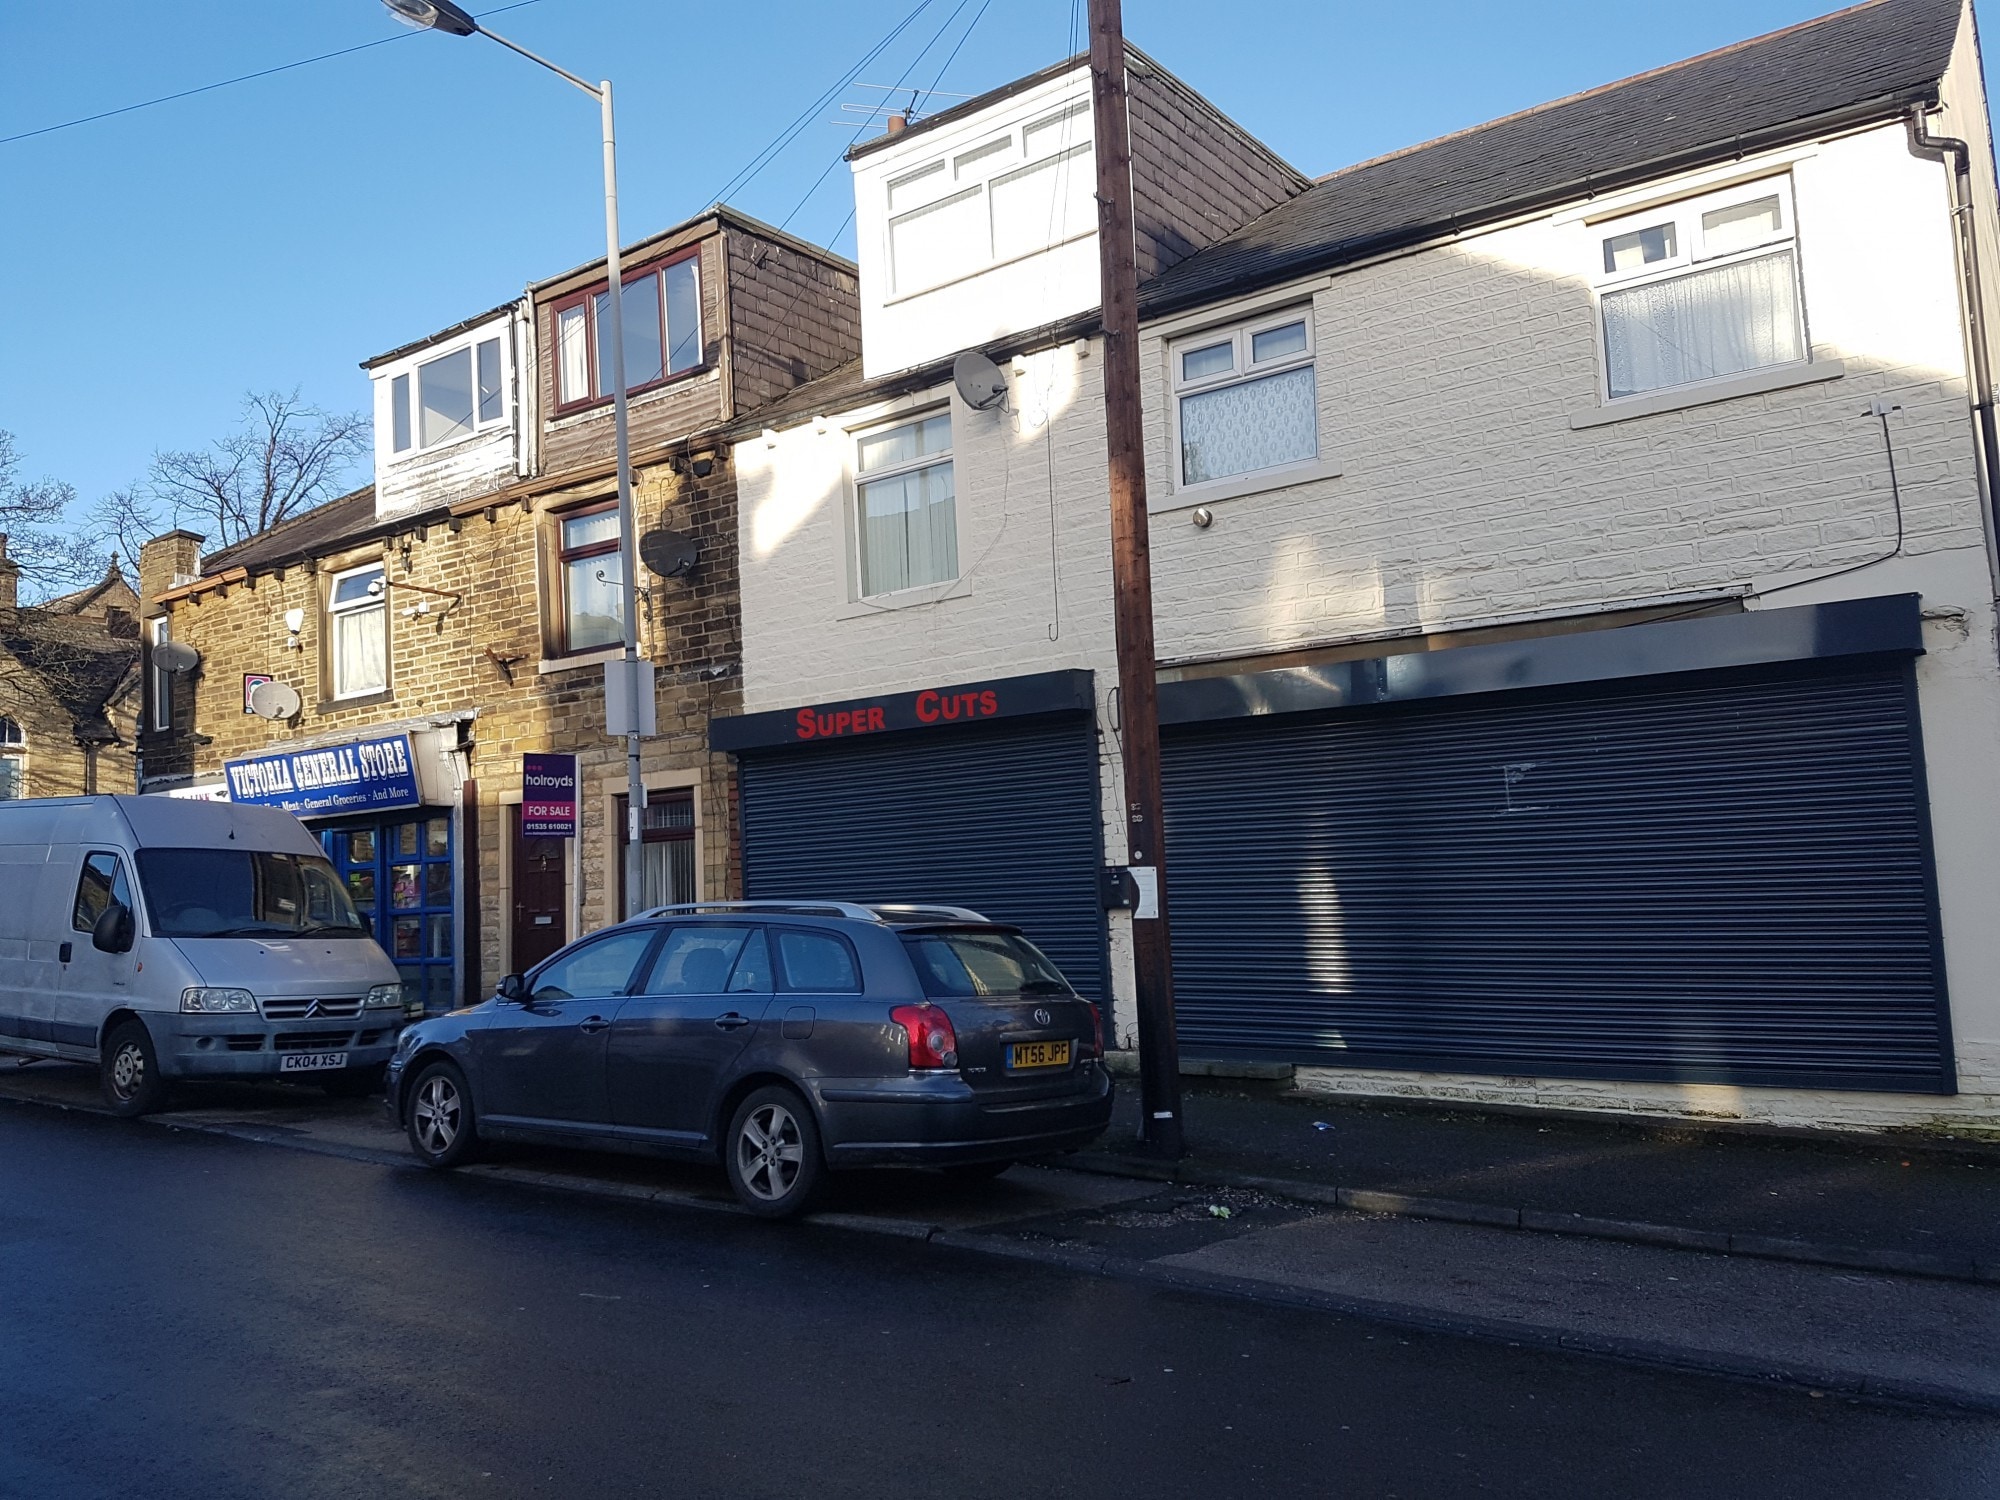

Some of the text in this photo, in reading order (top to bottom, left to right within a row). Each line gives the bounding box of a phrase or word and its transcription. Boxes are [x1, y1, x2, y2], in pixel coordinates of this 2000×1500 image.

[230, 740, 408, 799] VICTORIA GENERAL STORE
[525, 773, 574, 789] holroyds
[304, 795, 333, 809] General
[333, 792, 367, 806] Groceries
[372, 788, 389, 801] And
[389, 786, 409, 798] More
[528, 806, 571, 816] FOR SALE
[526, 823, 547, 831] 01535
[286, 1054, 344, 1069] CK04 XSJ
[1014, 1043, 1067, 1065] MT56 JPF
